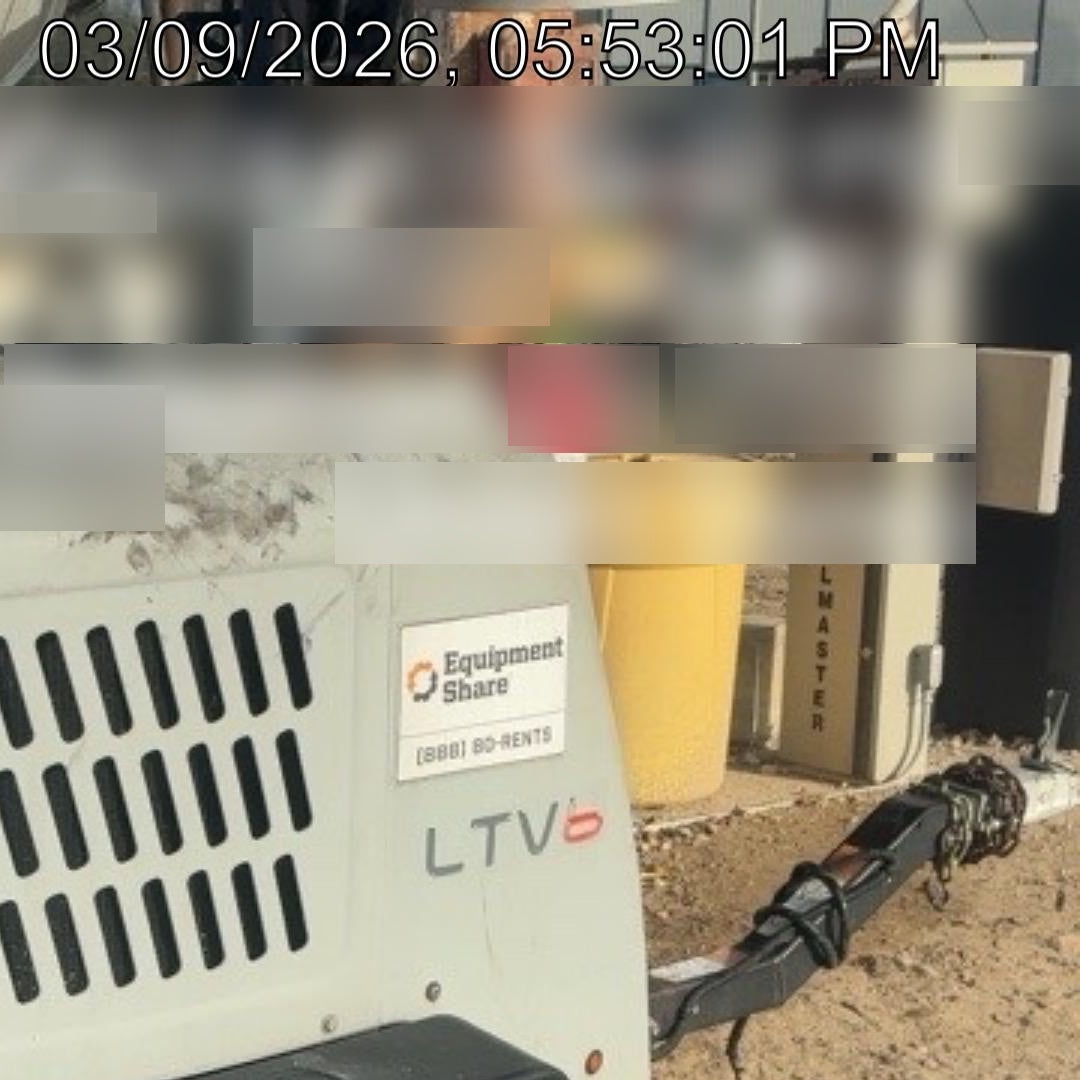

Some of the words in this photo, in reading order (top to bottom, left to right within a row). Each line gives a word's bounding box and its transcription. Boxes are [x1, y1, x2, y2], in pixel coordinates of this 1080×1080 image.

[442, 635, 564, 678] Equipment
[811, 564, 834, 732] LMASTER
[442, 676, 509, 703] Share
